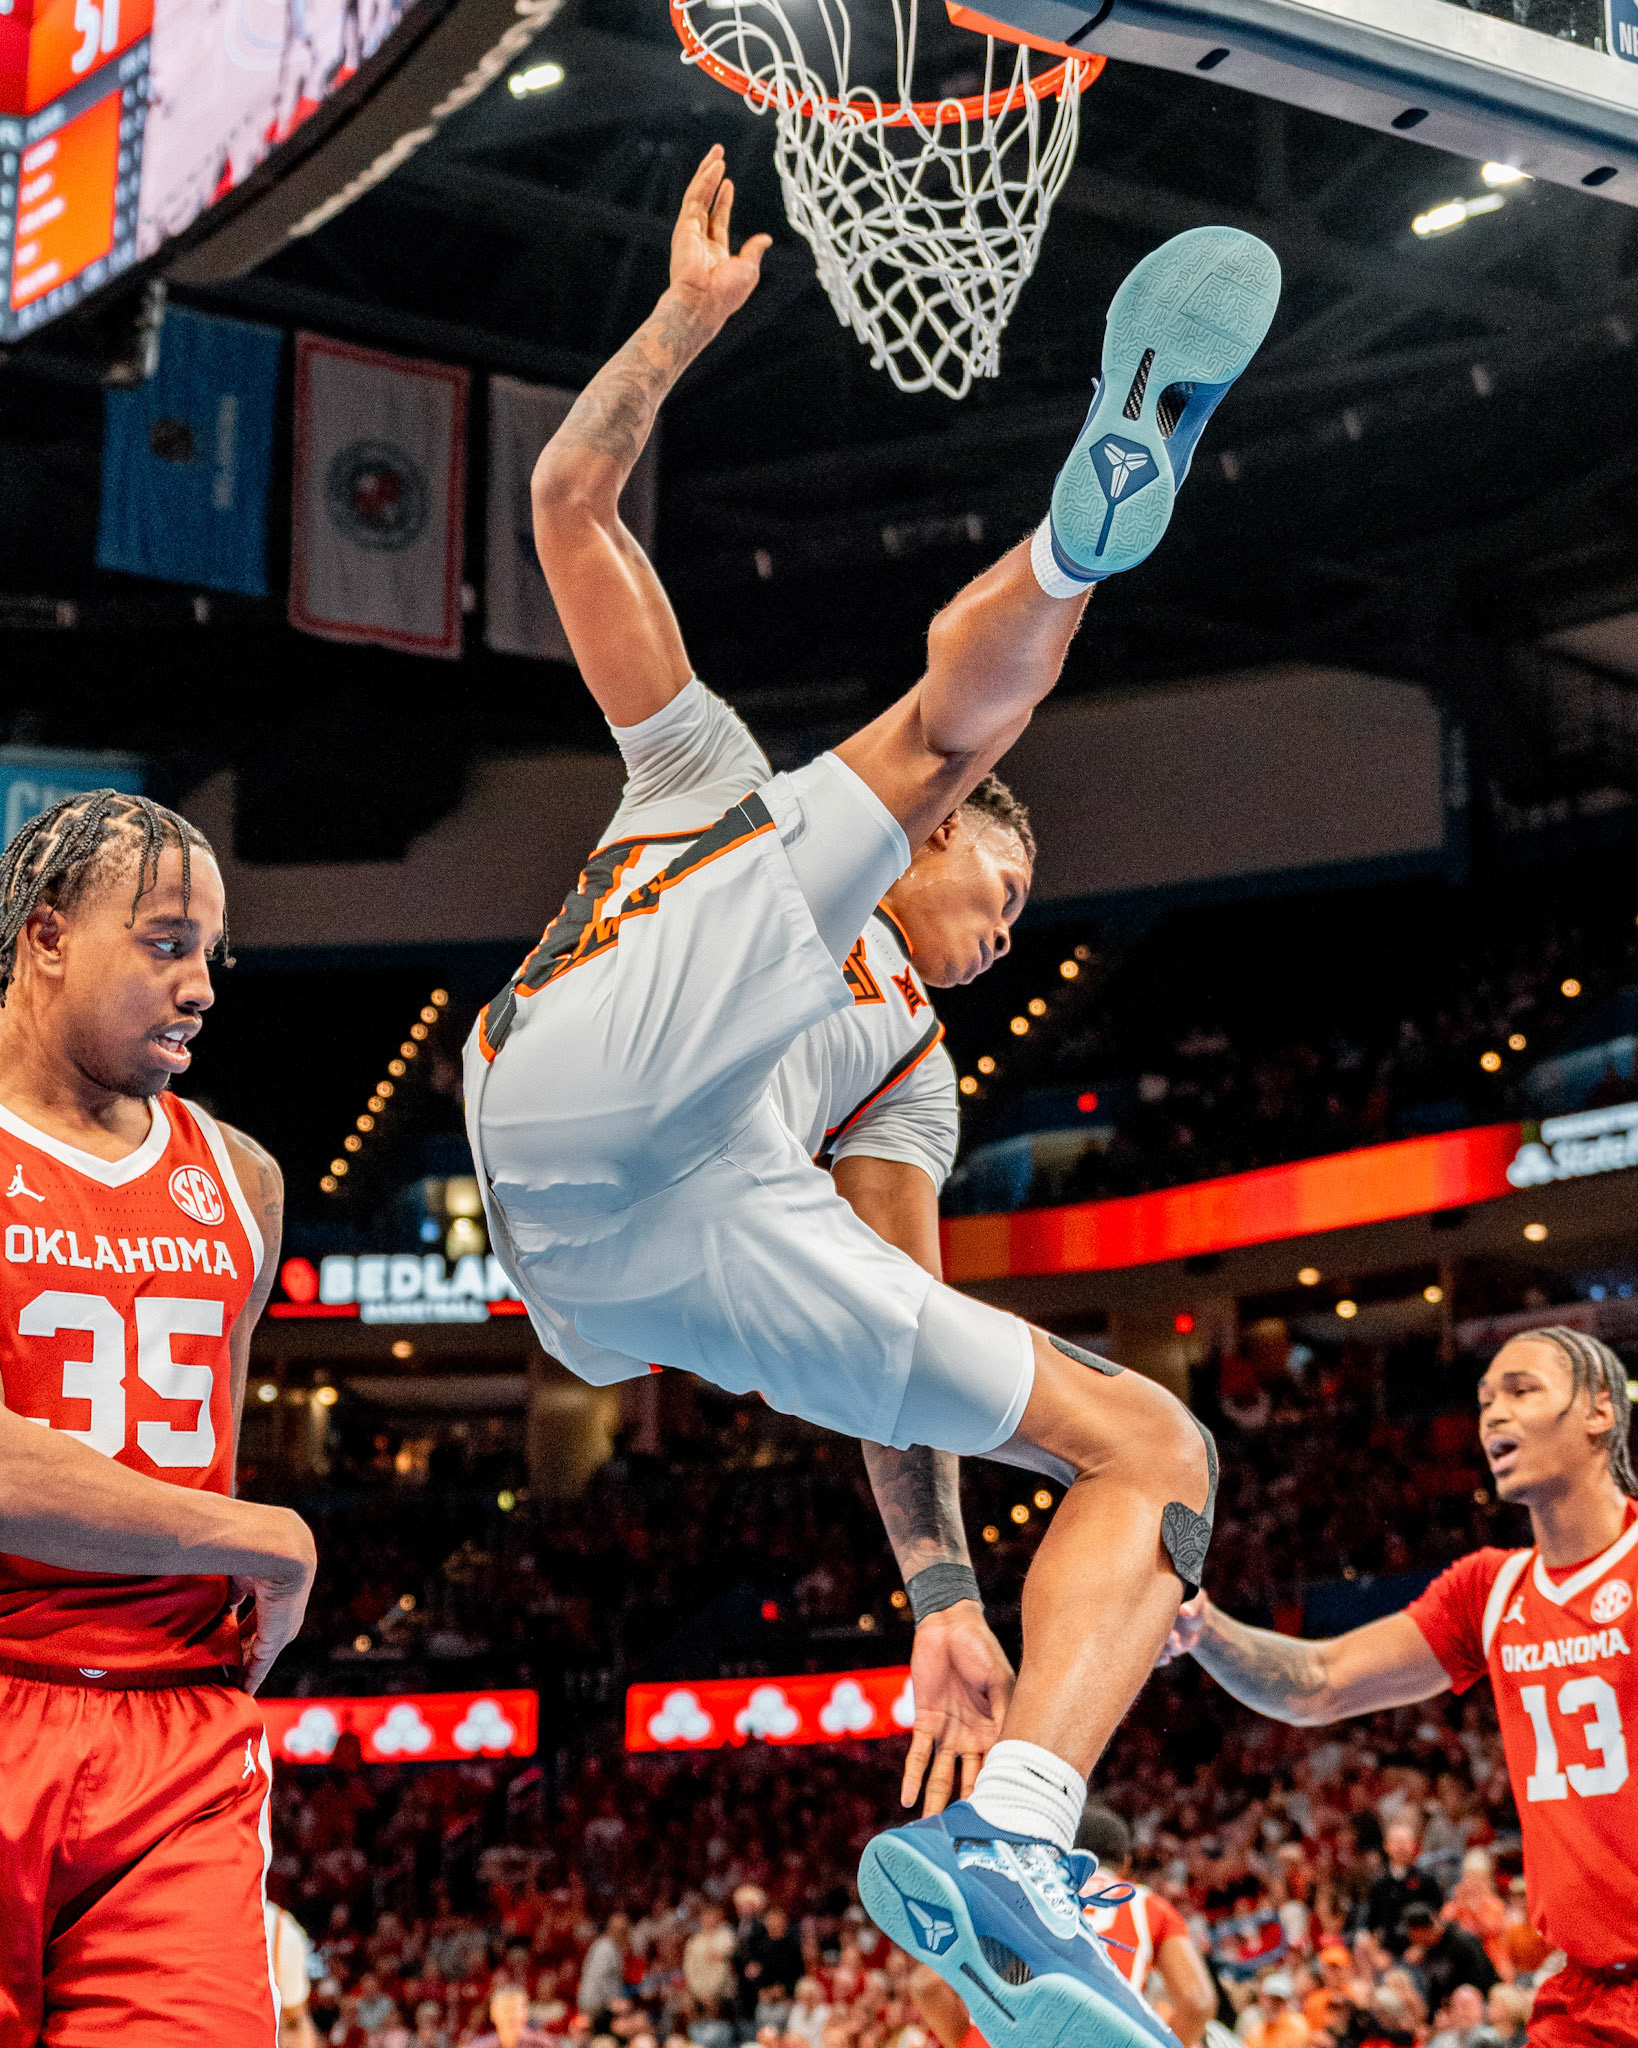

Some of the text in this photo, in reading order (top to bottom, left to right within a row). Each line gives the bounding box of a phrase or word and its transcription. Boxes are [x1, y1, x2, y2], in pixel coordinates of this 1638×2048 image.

[173, 1168, 223, 1222] SEC
[5, 1224, 237, 1280] OKLAHOMA
[18, 1290, 224, 1467] 35
[1501, 1627, 1631, 1673] OKLAHOMA
[1520, 1675, 1629, 1802] 13
